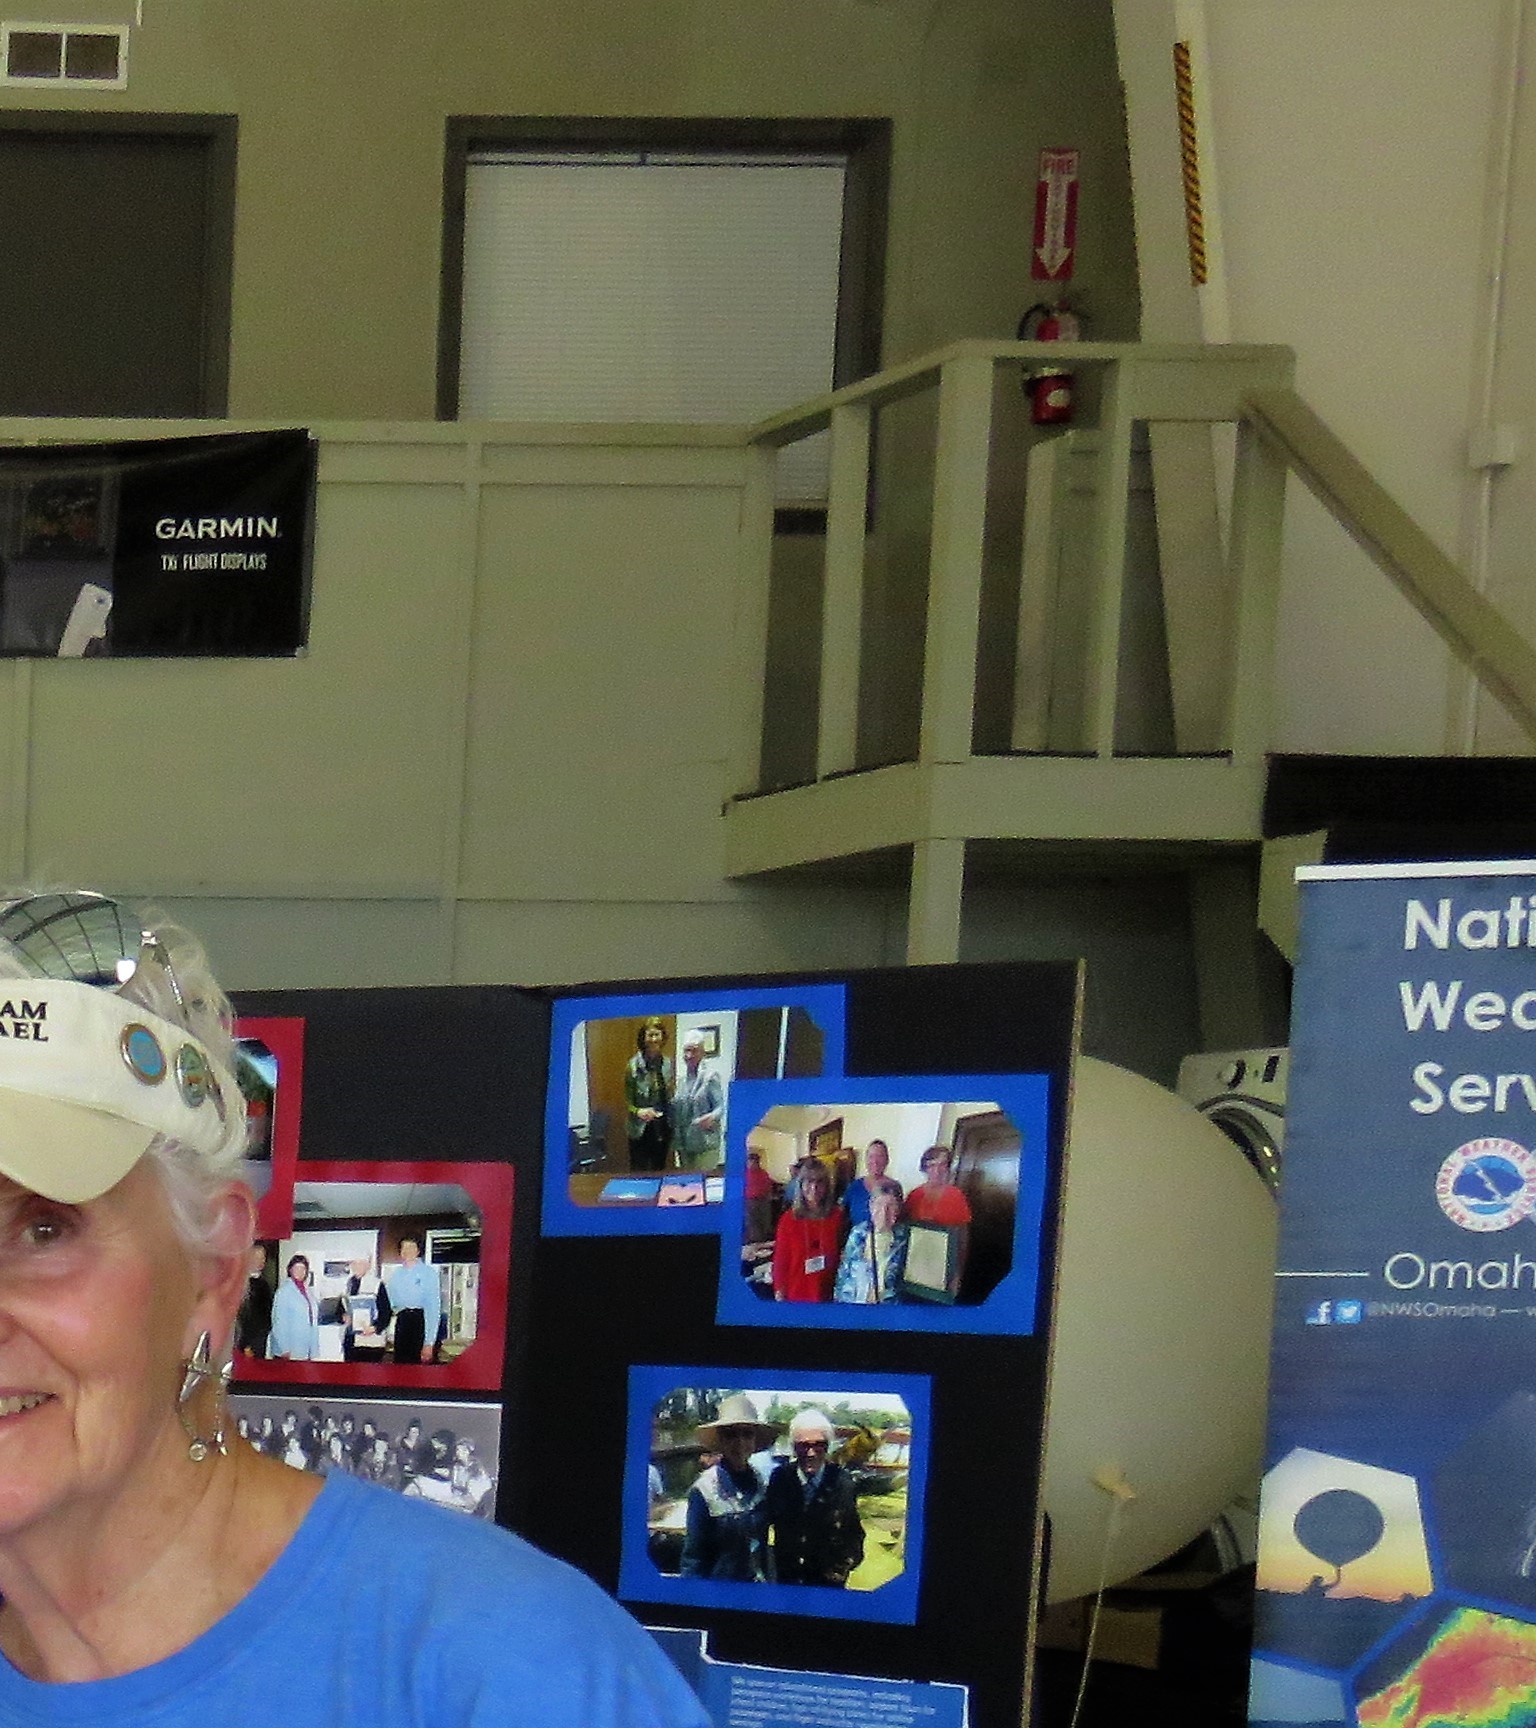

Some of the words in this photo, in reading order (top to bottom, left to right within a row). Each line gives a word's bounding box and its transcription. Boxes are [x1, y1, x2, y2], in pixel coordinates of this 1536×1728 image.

[155, 516, 278, 540] GARMIN
[182, 552, 219, 571] FLIGHT
[220, 552, 268, 571] DISPLAYS
